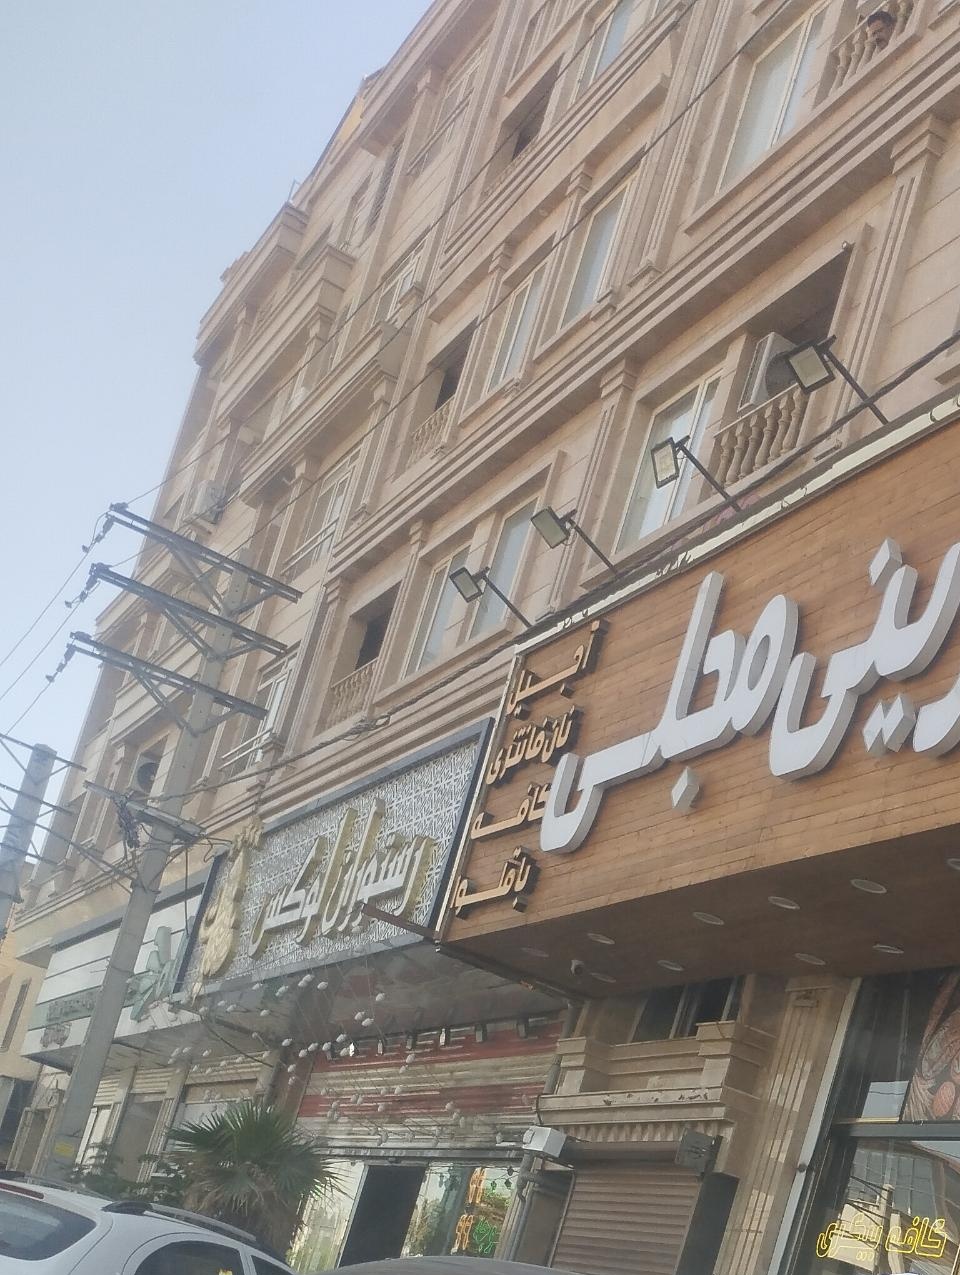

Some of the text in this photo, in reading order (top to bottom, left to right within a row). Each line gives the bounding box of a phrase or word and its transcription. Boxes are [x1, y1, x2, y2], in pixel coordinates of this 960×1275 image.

[486, 705, 577, 785] نان فانتزی
[540, 570, 798, 854] مجلسی
[471, 782, 553, 840] کافه
[249, 798, 436, 958] رستوران لوکس
[450, 846, 533, 915] باقلوا
[885, 1216, 948, 1258] کافه
